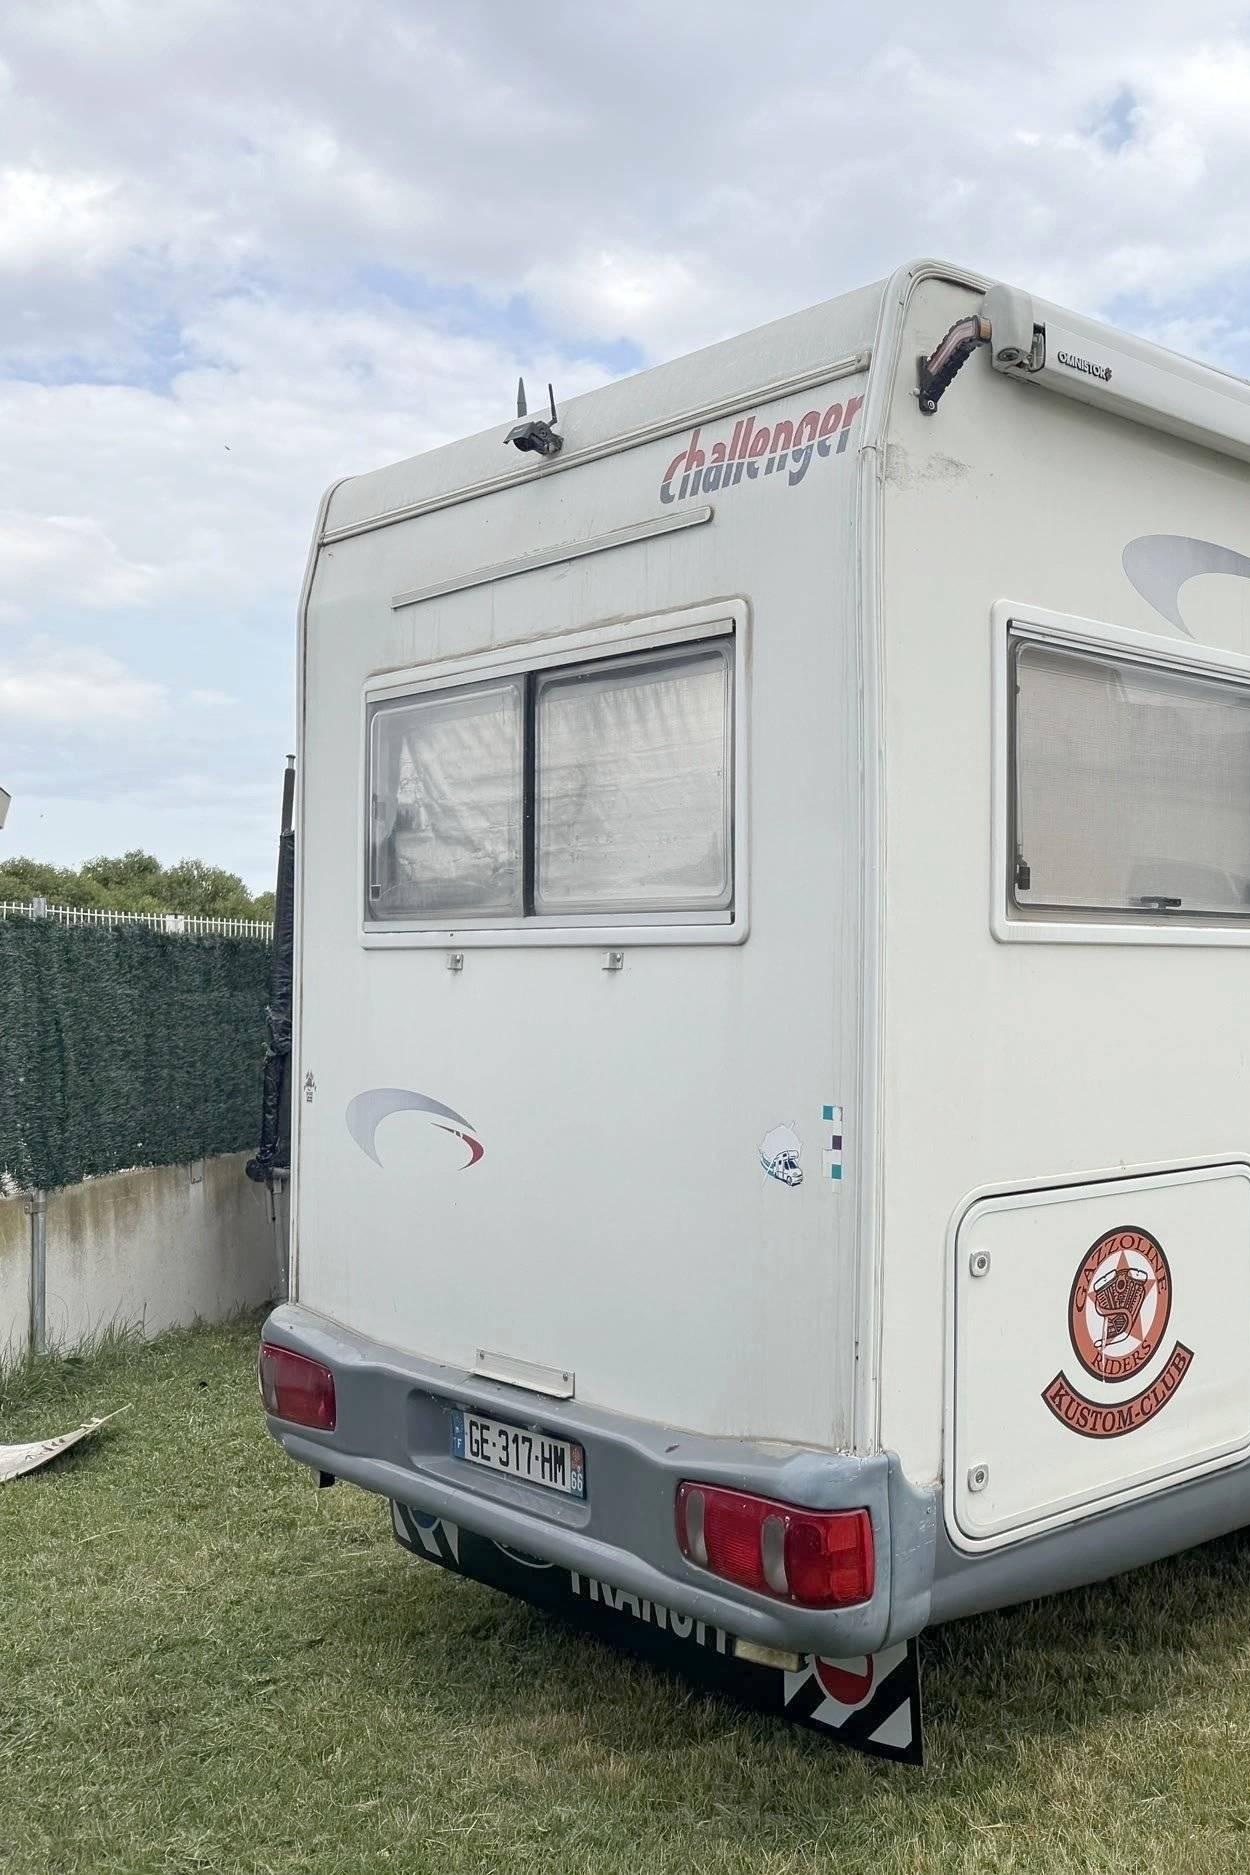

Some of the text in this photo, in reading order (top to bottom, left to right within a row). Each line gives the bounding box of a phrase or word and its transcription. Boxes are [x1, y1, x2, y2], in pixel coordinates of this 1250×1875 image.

[1075, 1234, 1167, 1313] GAZZOLINE
[1049, 1351, 1188, 1433] KUSTOM-CLUB
[1091, 1340, 1152, 1375] RIDERS
[457, 1419, 583, 1492] F GE-317-HM 66
